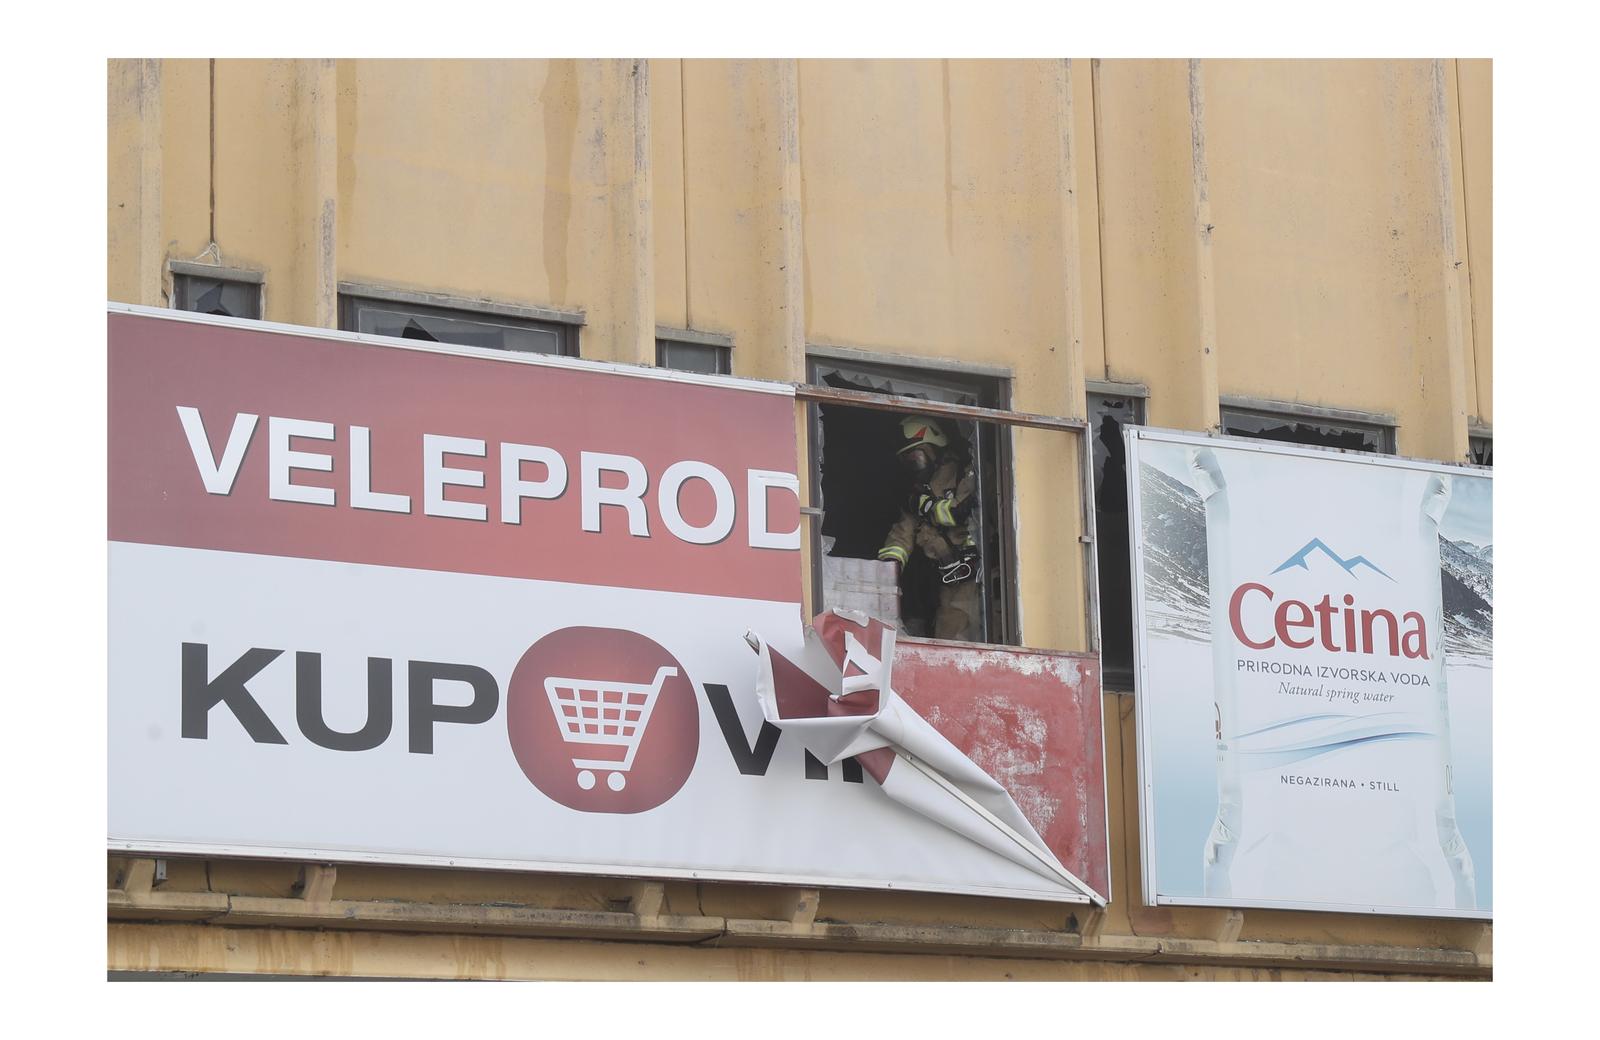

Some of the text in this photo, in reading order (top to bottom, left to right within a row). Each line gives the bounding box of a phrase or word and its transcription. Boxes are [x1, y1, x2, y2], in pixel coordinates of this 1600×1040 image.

[176, 405, 801, 551] VELEPROD
[1228, 582, 1430, 661] Cetina
[1237, 659, 1431, 687] PRIRODNA IZVORSKA VODA
[1278, 682, 1395, 704] Natural spring water
[1280, 775, 1400, 792] NEGAZIRANA STILL
